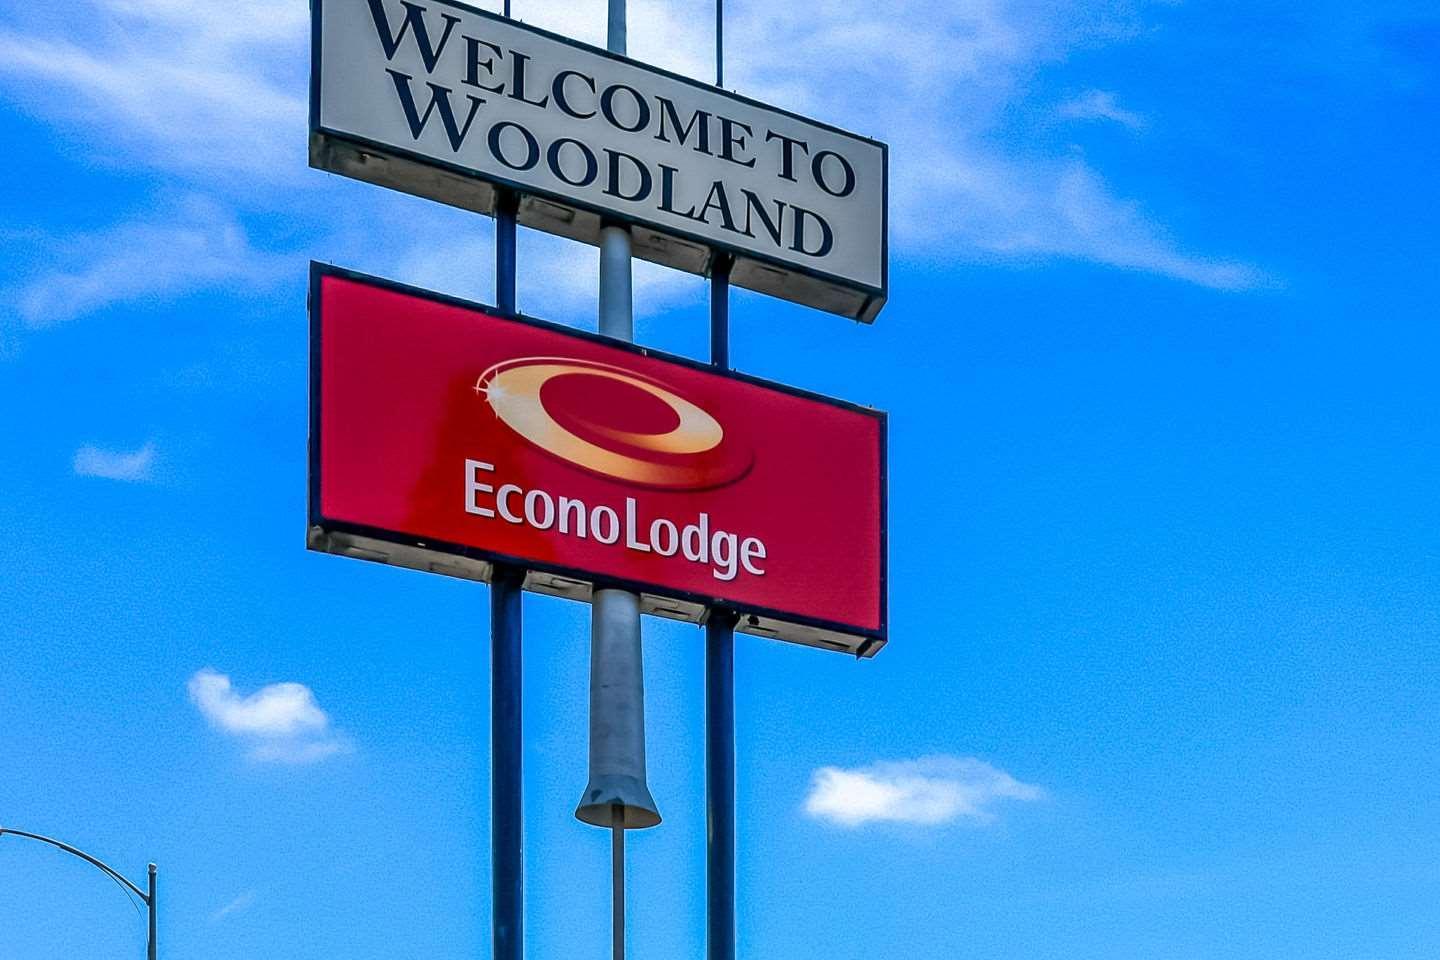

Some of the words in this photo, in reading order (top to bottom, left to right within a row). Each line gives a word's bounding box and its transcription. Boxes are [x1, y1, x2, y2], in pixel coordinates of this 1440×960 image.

[366, 0, 756, 169] WELCOME
[766, 128, 856, 198] TO
[385, 67, 834, 258] WOODLAND
[464, 458, 768, 581] EconoLodge
